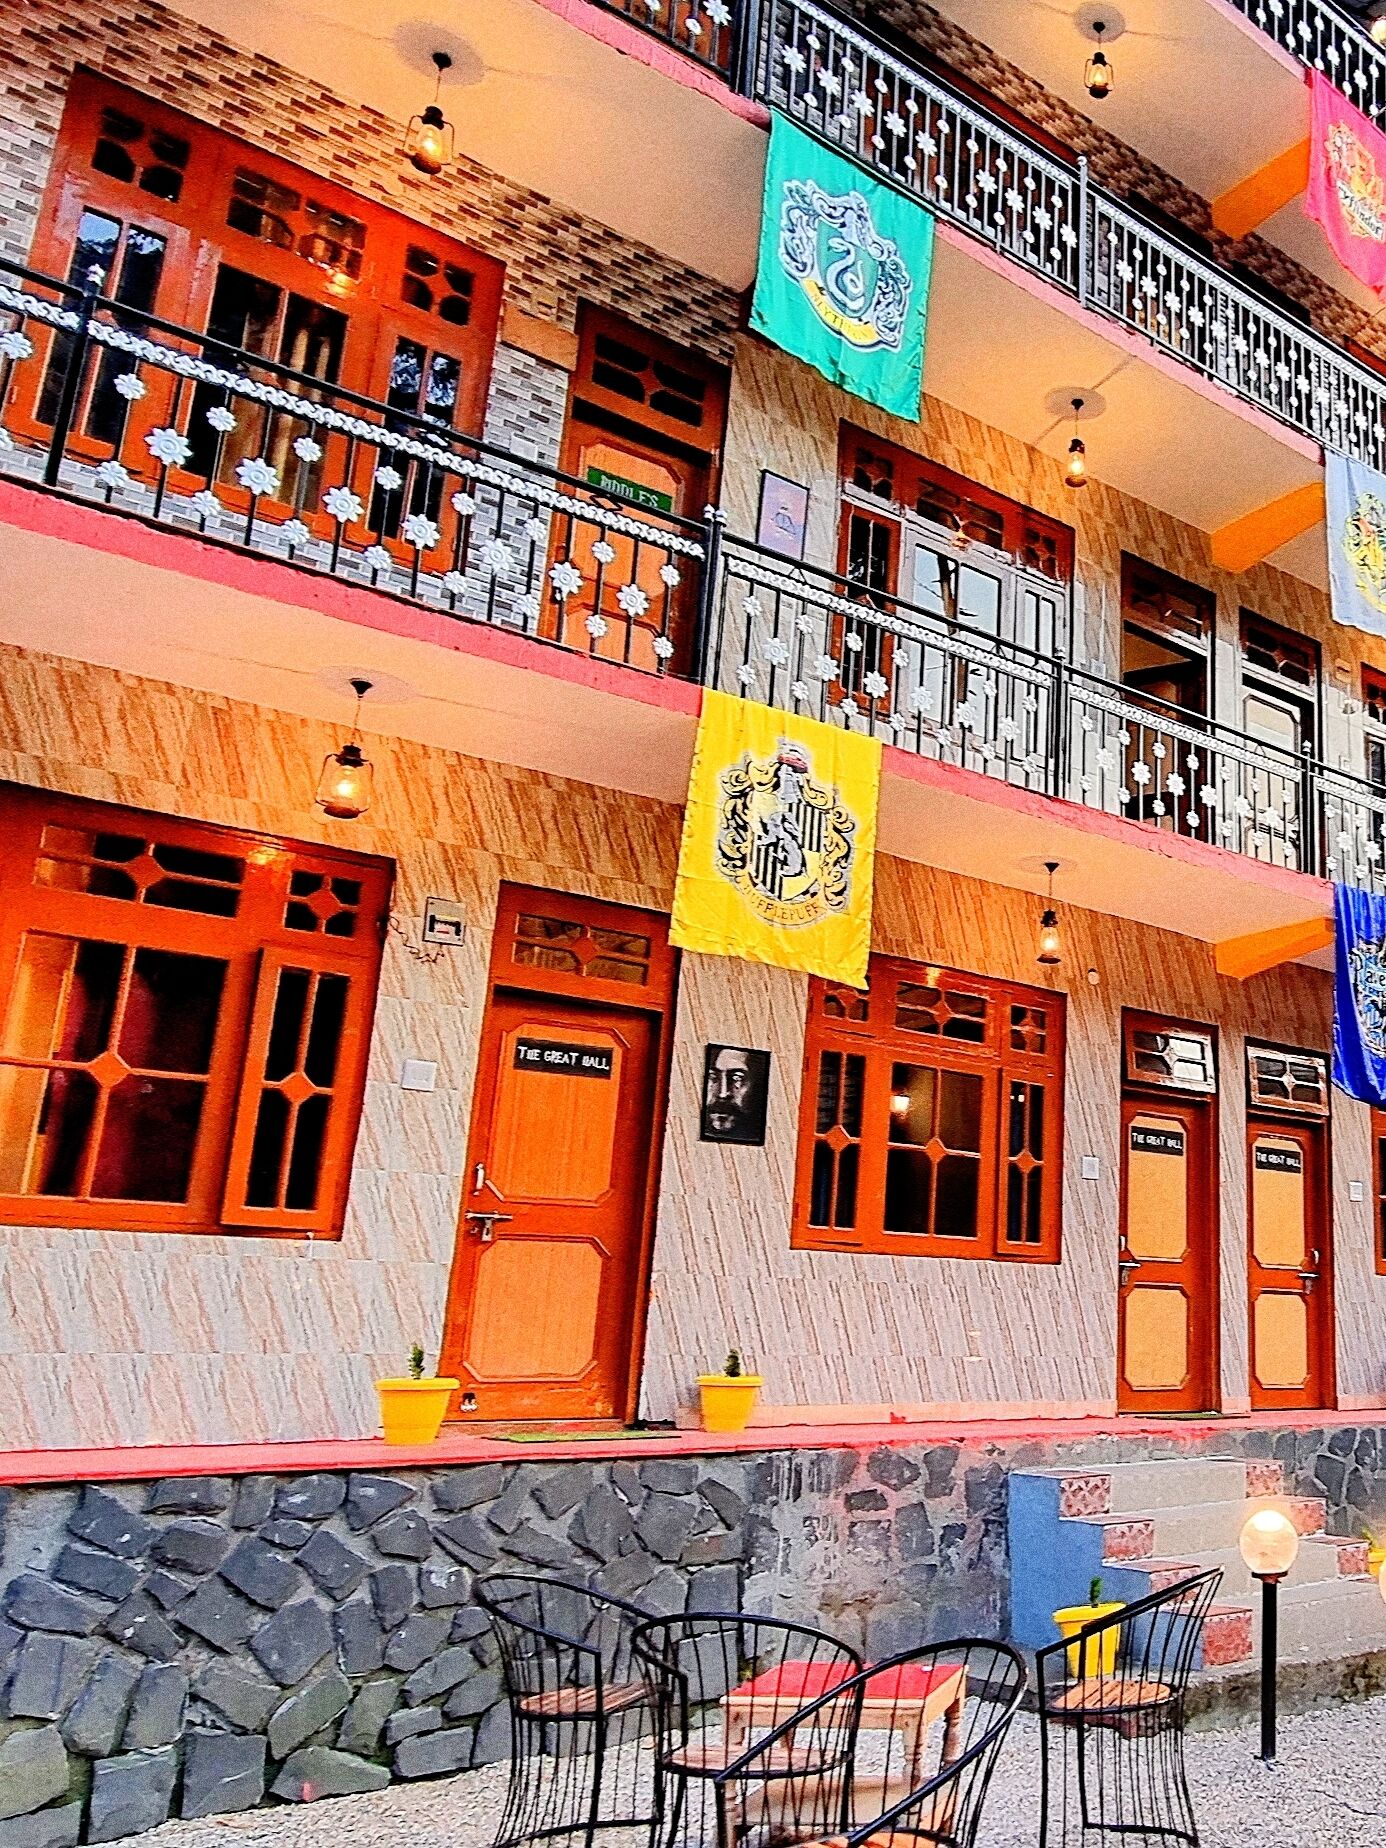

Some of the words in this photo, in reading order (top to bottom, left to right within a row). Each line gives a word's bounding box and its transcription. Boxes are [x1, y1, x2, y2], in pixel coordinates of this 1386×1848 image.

[517, 1045, 542, 1060] THE
[543, 1050, 580, 1067] GREAT
[581, 1055, 610, 1070] HALL
